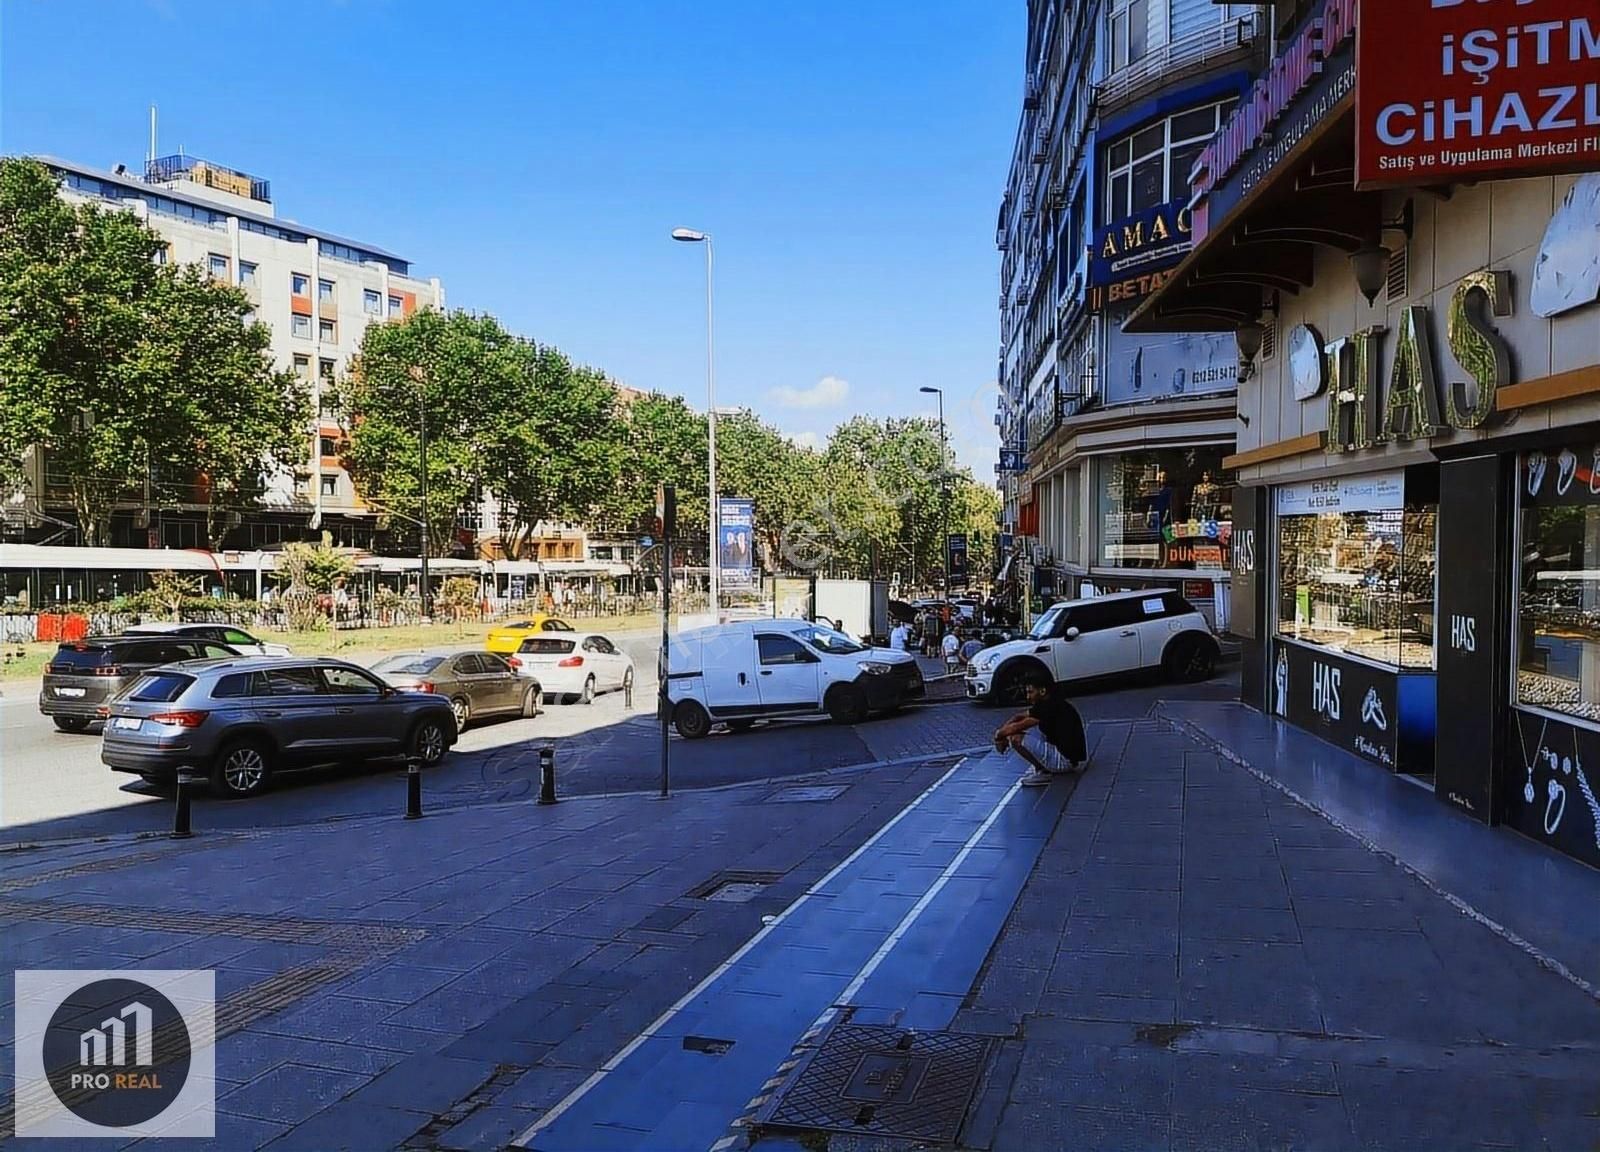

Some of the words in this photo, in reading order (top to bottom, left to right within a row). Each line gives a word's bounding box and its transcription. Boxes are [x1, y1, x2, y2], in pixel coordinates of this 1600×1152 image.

[1379, 155, 1415, 171] Satış
[1419, 154, 1435, 166] ve
[1441, 146, 1513, 165] Uygulama
[1518, 138, 1577, 158] Merkezi
[1325, 271, 1512, 455] HAS
[1233, 529, 1255, 571] HAS
[1451, 614, 1476, 652] HAS
[1313, 661, 1341, 720] HAS
